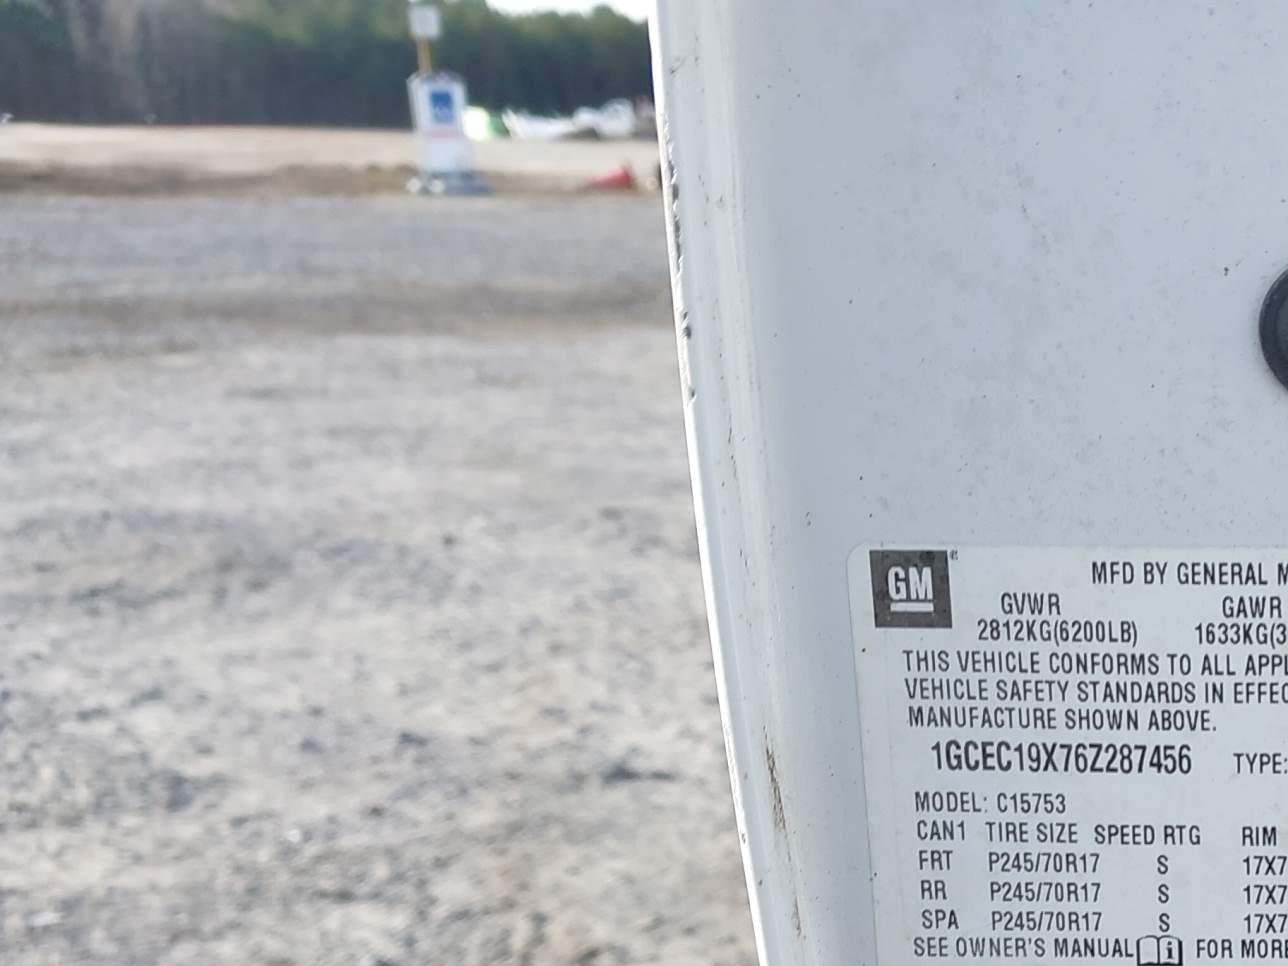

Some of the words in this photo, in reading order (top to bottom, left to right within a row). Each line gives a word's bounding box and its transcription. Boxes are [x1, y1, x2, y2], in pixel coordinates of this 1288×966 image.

[888, 567, 933, 600] GM
[1092, 562, 1134, 584] MFD
[1144, 562, 1167, 584] BY
[1178, 563, 1267, 585] GENERAL
[1001, 593, 1060, 615] GVWR
[1223, 596, 1281, 618] GAWR
[978, 619, 1137, 647] 2812KG(6200LB)
[903, 650, 949, 672] THIS
[957, 651, 1040, 673] VEHICLE
[1050, 653, 1159, 675] CONFORMS
[1167, 654, 1191, 675] TO
[1201, 654, 1235, 675] ALL
[904, 678, 988, 700] VEHICLE
[996, 680, 1068, 701] SAFETY
[1077, 681, 1195, 703] STANDARDS
[1205, 683, 1223, 703] IN
[909, 706, 1056, 729] MANUFACTURE
[1065, 709, 1138, 730] SHOWN
[1148, 710, 1216, 731] ABOVE.
[932, 740, 1191, 774] 1GCEC19X76Z287456
[1234, 753, 1287, 774] TYPE:
[915, 792, 986, 812] MODEL:
[997, 793, 1065, 813] C15753
[917, 820, 964, 840] CAN1
[985, 822, 1028, 842] TIRE
[1037, 823, 1077, 843] SIZE
[1095, 825, 1154, 845] SPEED
[1164, 825, 1200, 845] RTG
[1242, 827, 1276, 846] RIM
[919, 850, 952, 870] FRT
[989, 852, 1099, 872] P245/70R17
[1157, 855, 1168, 874] S
[921, 880, 947, 899] RR
[990, 882, 1100, 902] P245/70R17
[1158, 884, 1169, 903] S
[922, 909, 959, 929] SPA
[992, 911, 1101, 931] P245/70R17
[1159, 913, 1170, 932] S
[914, 937, 948, 957] SEE
[956, 937, 1045, 957] OWNER'S
[1054, 938, 1133, 957] MANUAL
[1197, 939, 1232, 958] FOR
